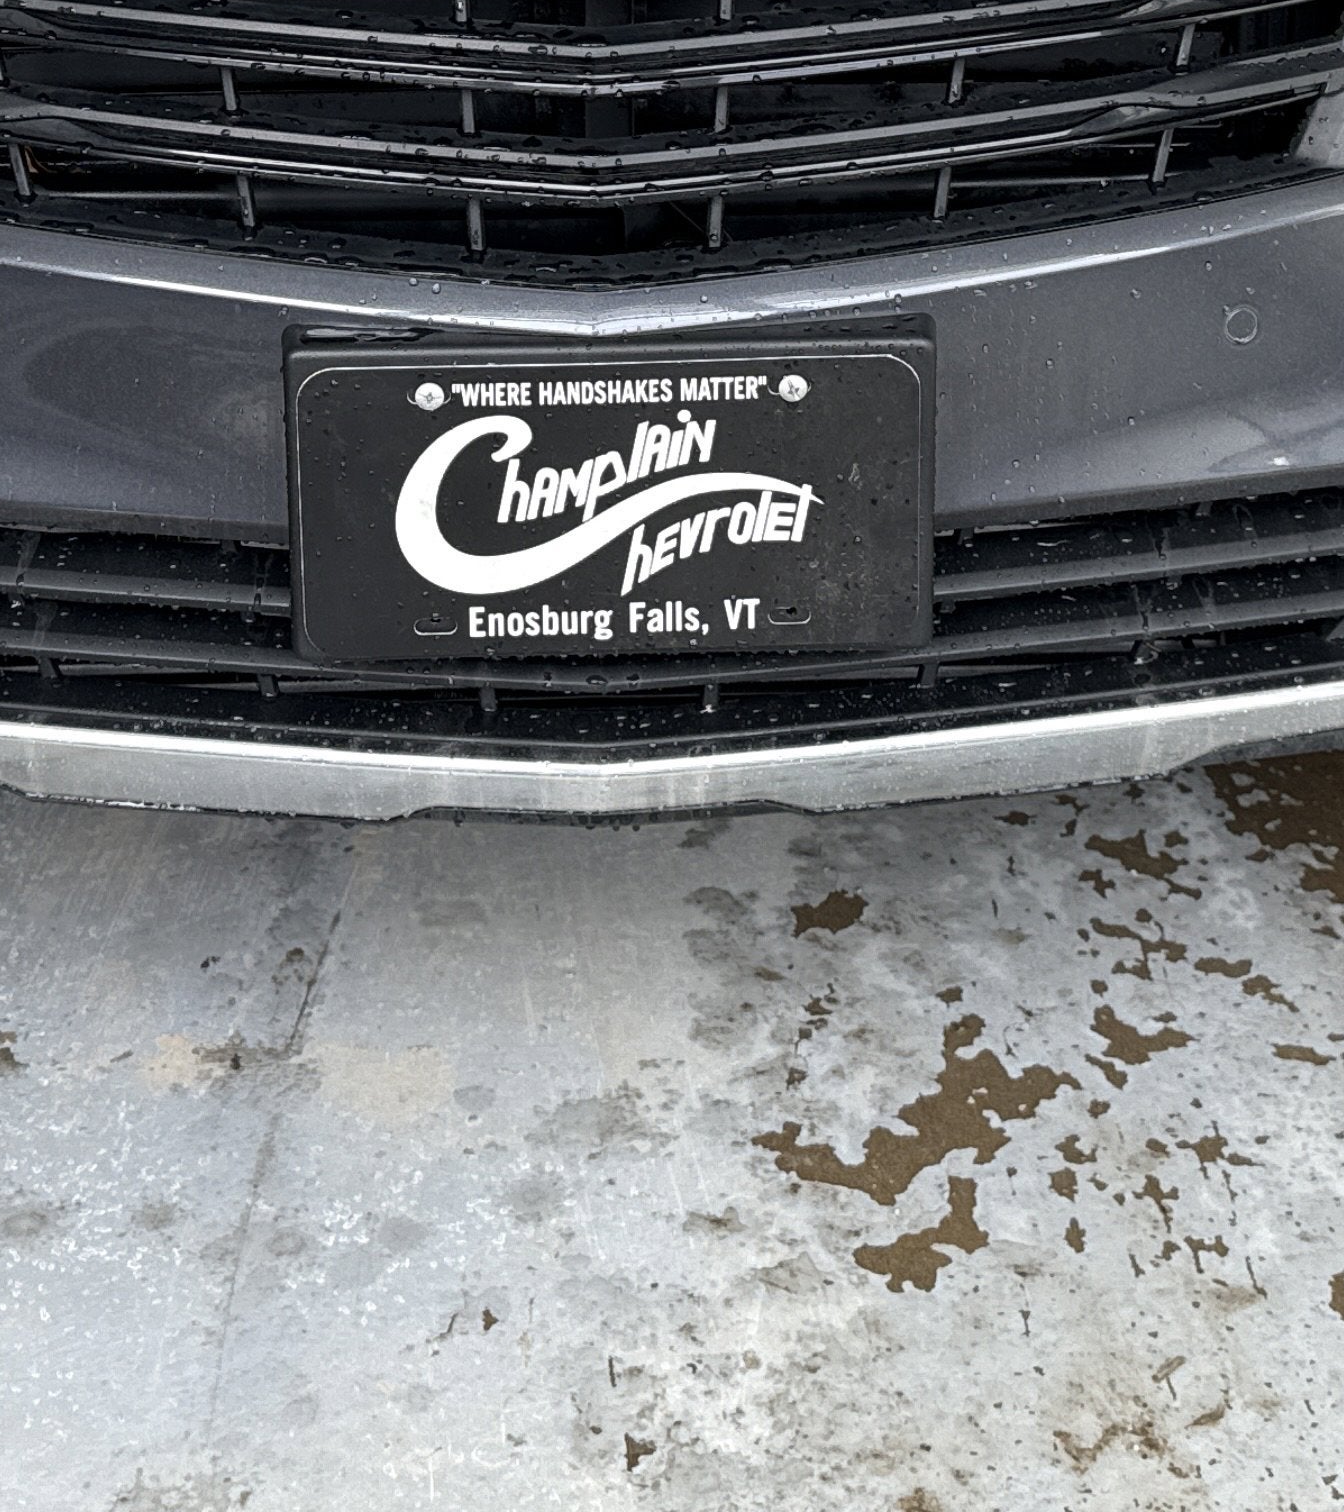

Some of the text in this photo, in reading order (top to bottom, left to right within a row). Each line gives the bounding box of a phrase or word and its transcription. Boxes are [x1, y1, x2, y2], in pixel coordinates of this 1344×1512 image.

[452, 376, 767, 407] "WHERE HANDSHAKES MATTER"
[469, 597, 761, 641] Enosburg Falls, VT
